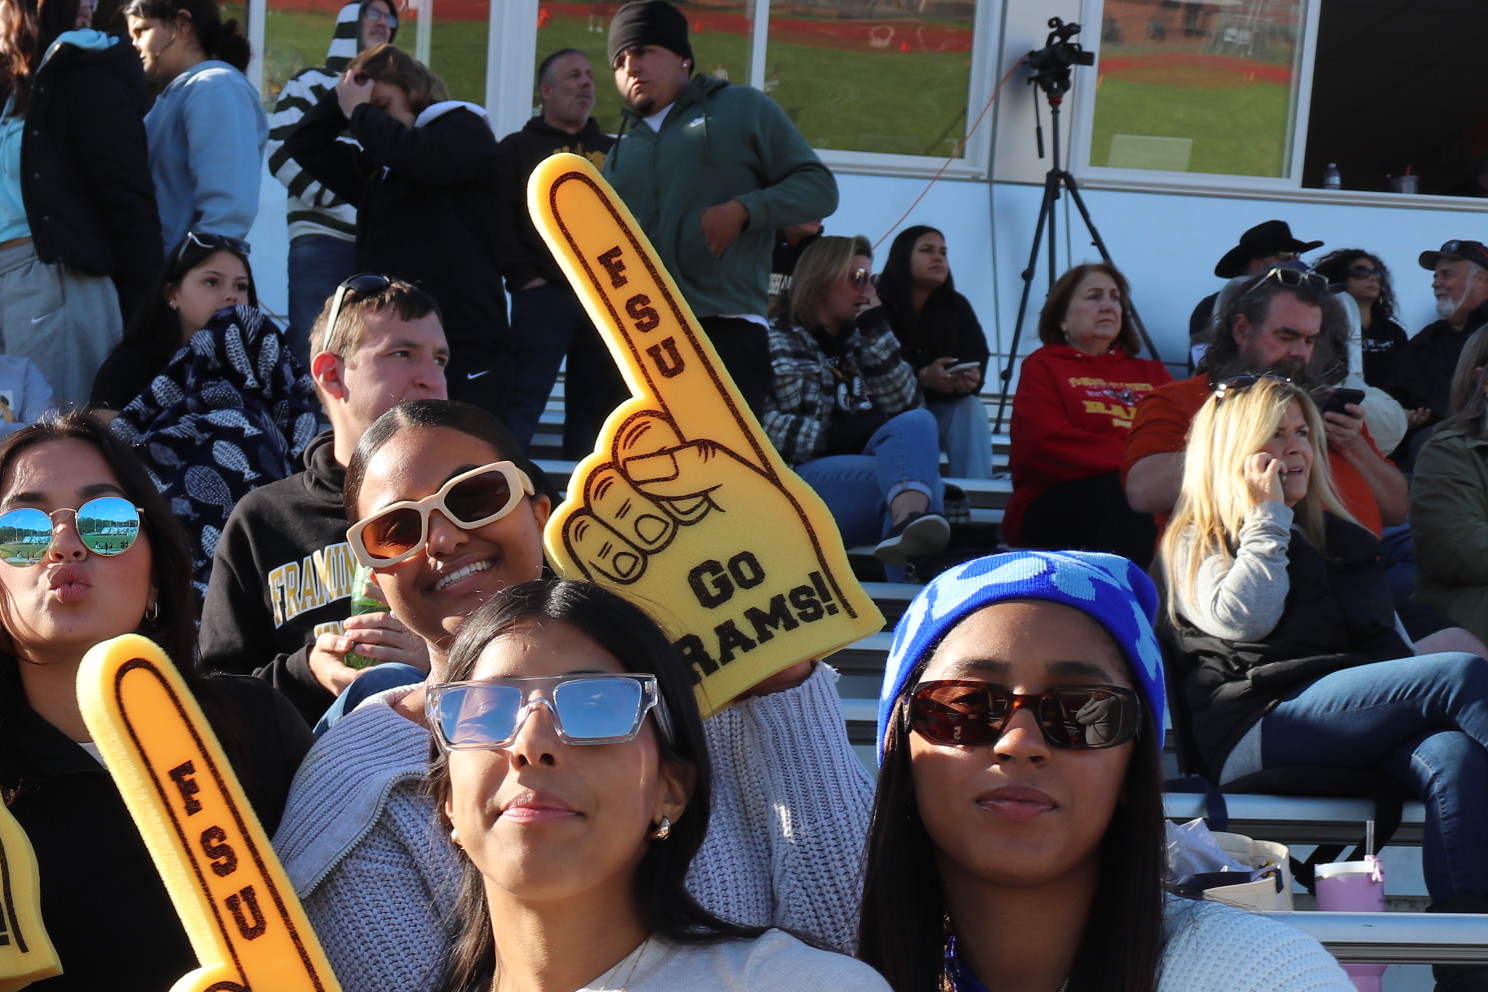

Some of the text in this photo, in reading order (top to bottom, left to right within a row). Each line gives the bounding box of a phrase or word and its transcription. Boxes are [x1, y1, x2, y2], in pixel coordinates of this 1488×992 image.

[597, 245, 686, 379] FSU
[687, 550, 767, 610] GO
[168, 760, 267, 942] FSU
